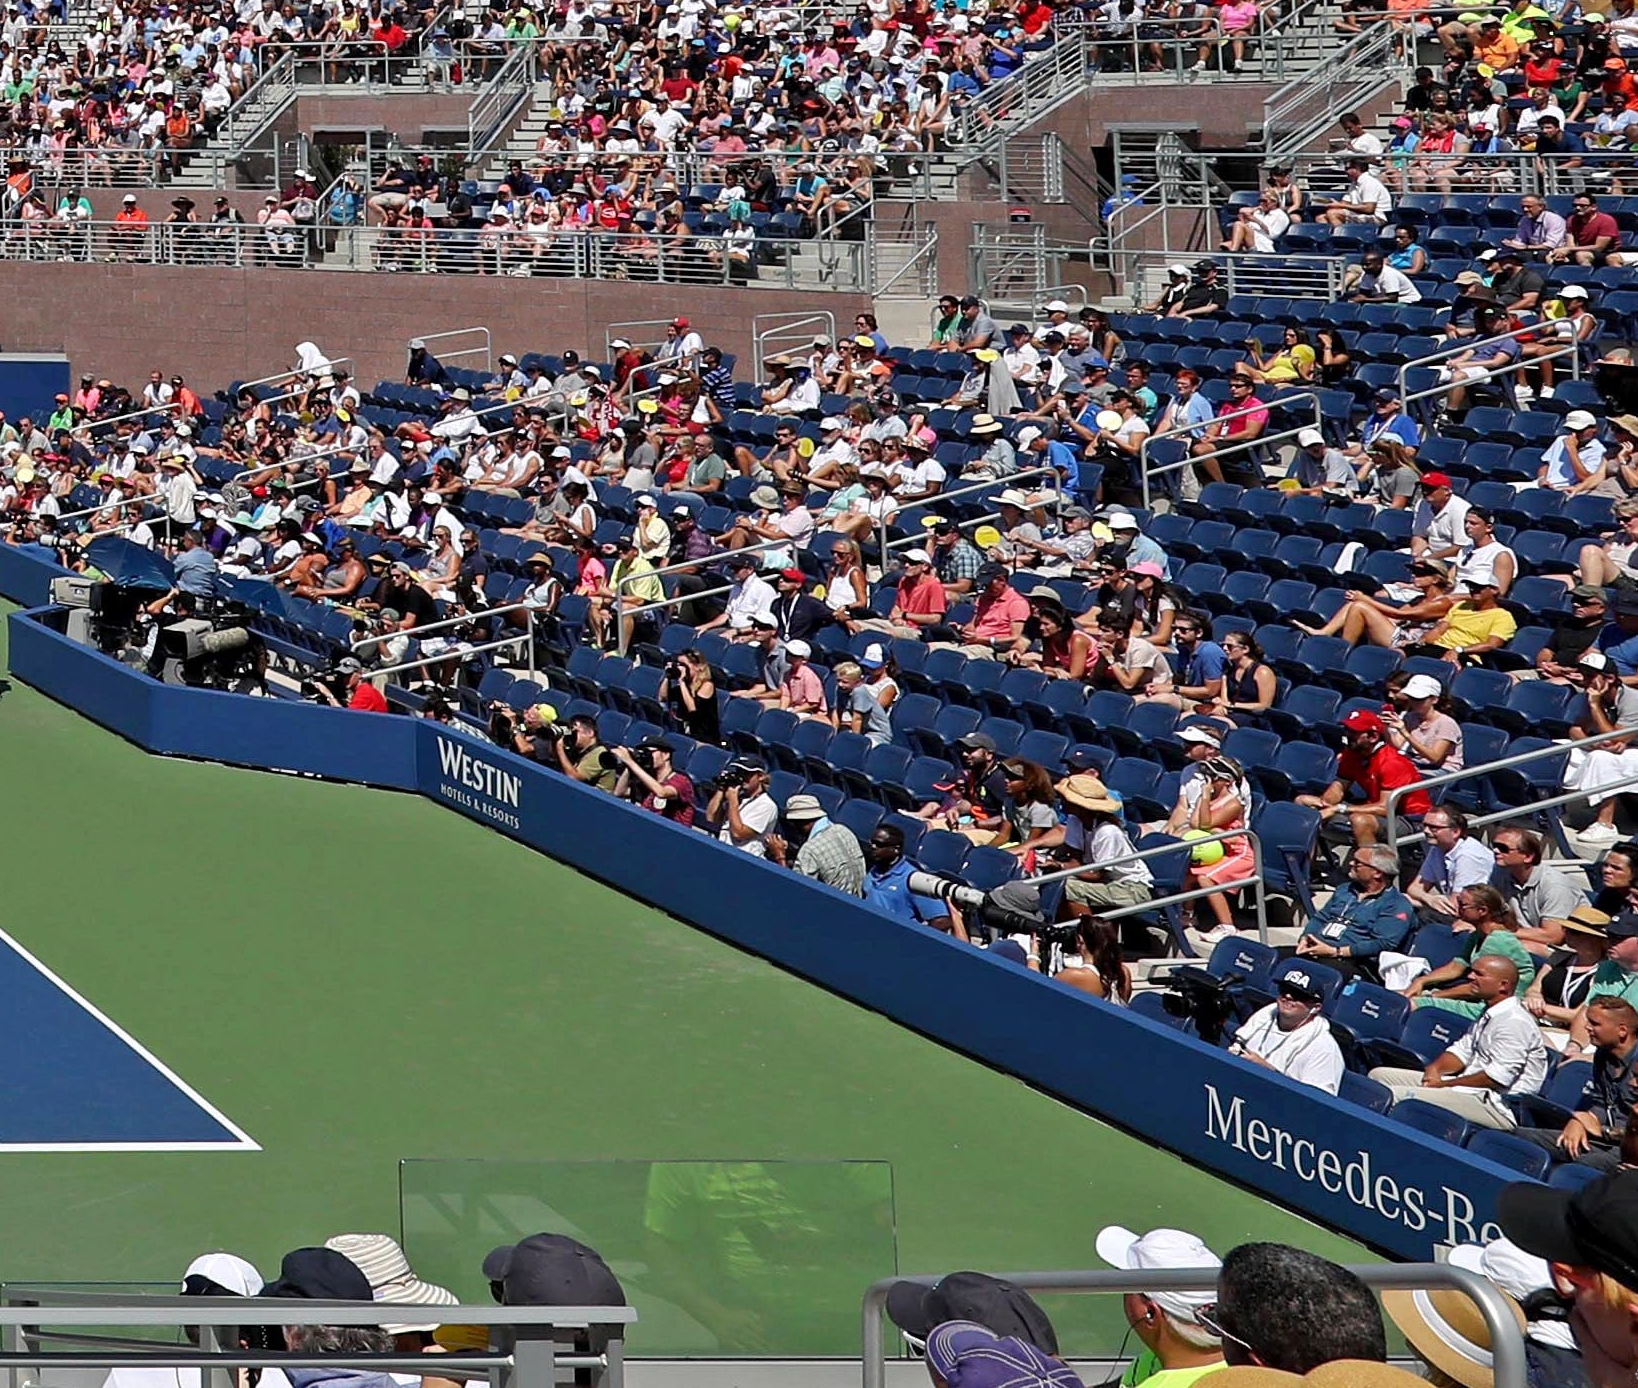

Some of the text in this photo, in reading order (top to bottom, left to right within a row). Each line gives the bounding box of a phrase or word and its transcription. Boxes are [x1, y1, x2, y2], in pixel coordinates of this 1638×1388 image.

[436, 735, 520, 808] WESTIN
[440, 783, 520, 830] HOTELS & RESORTS
[1283, 969, 1312, 989] USA
